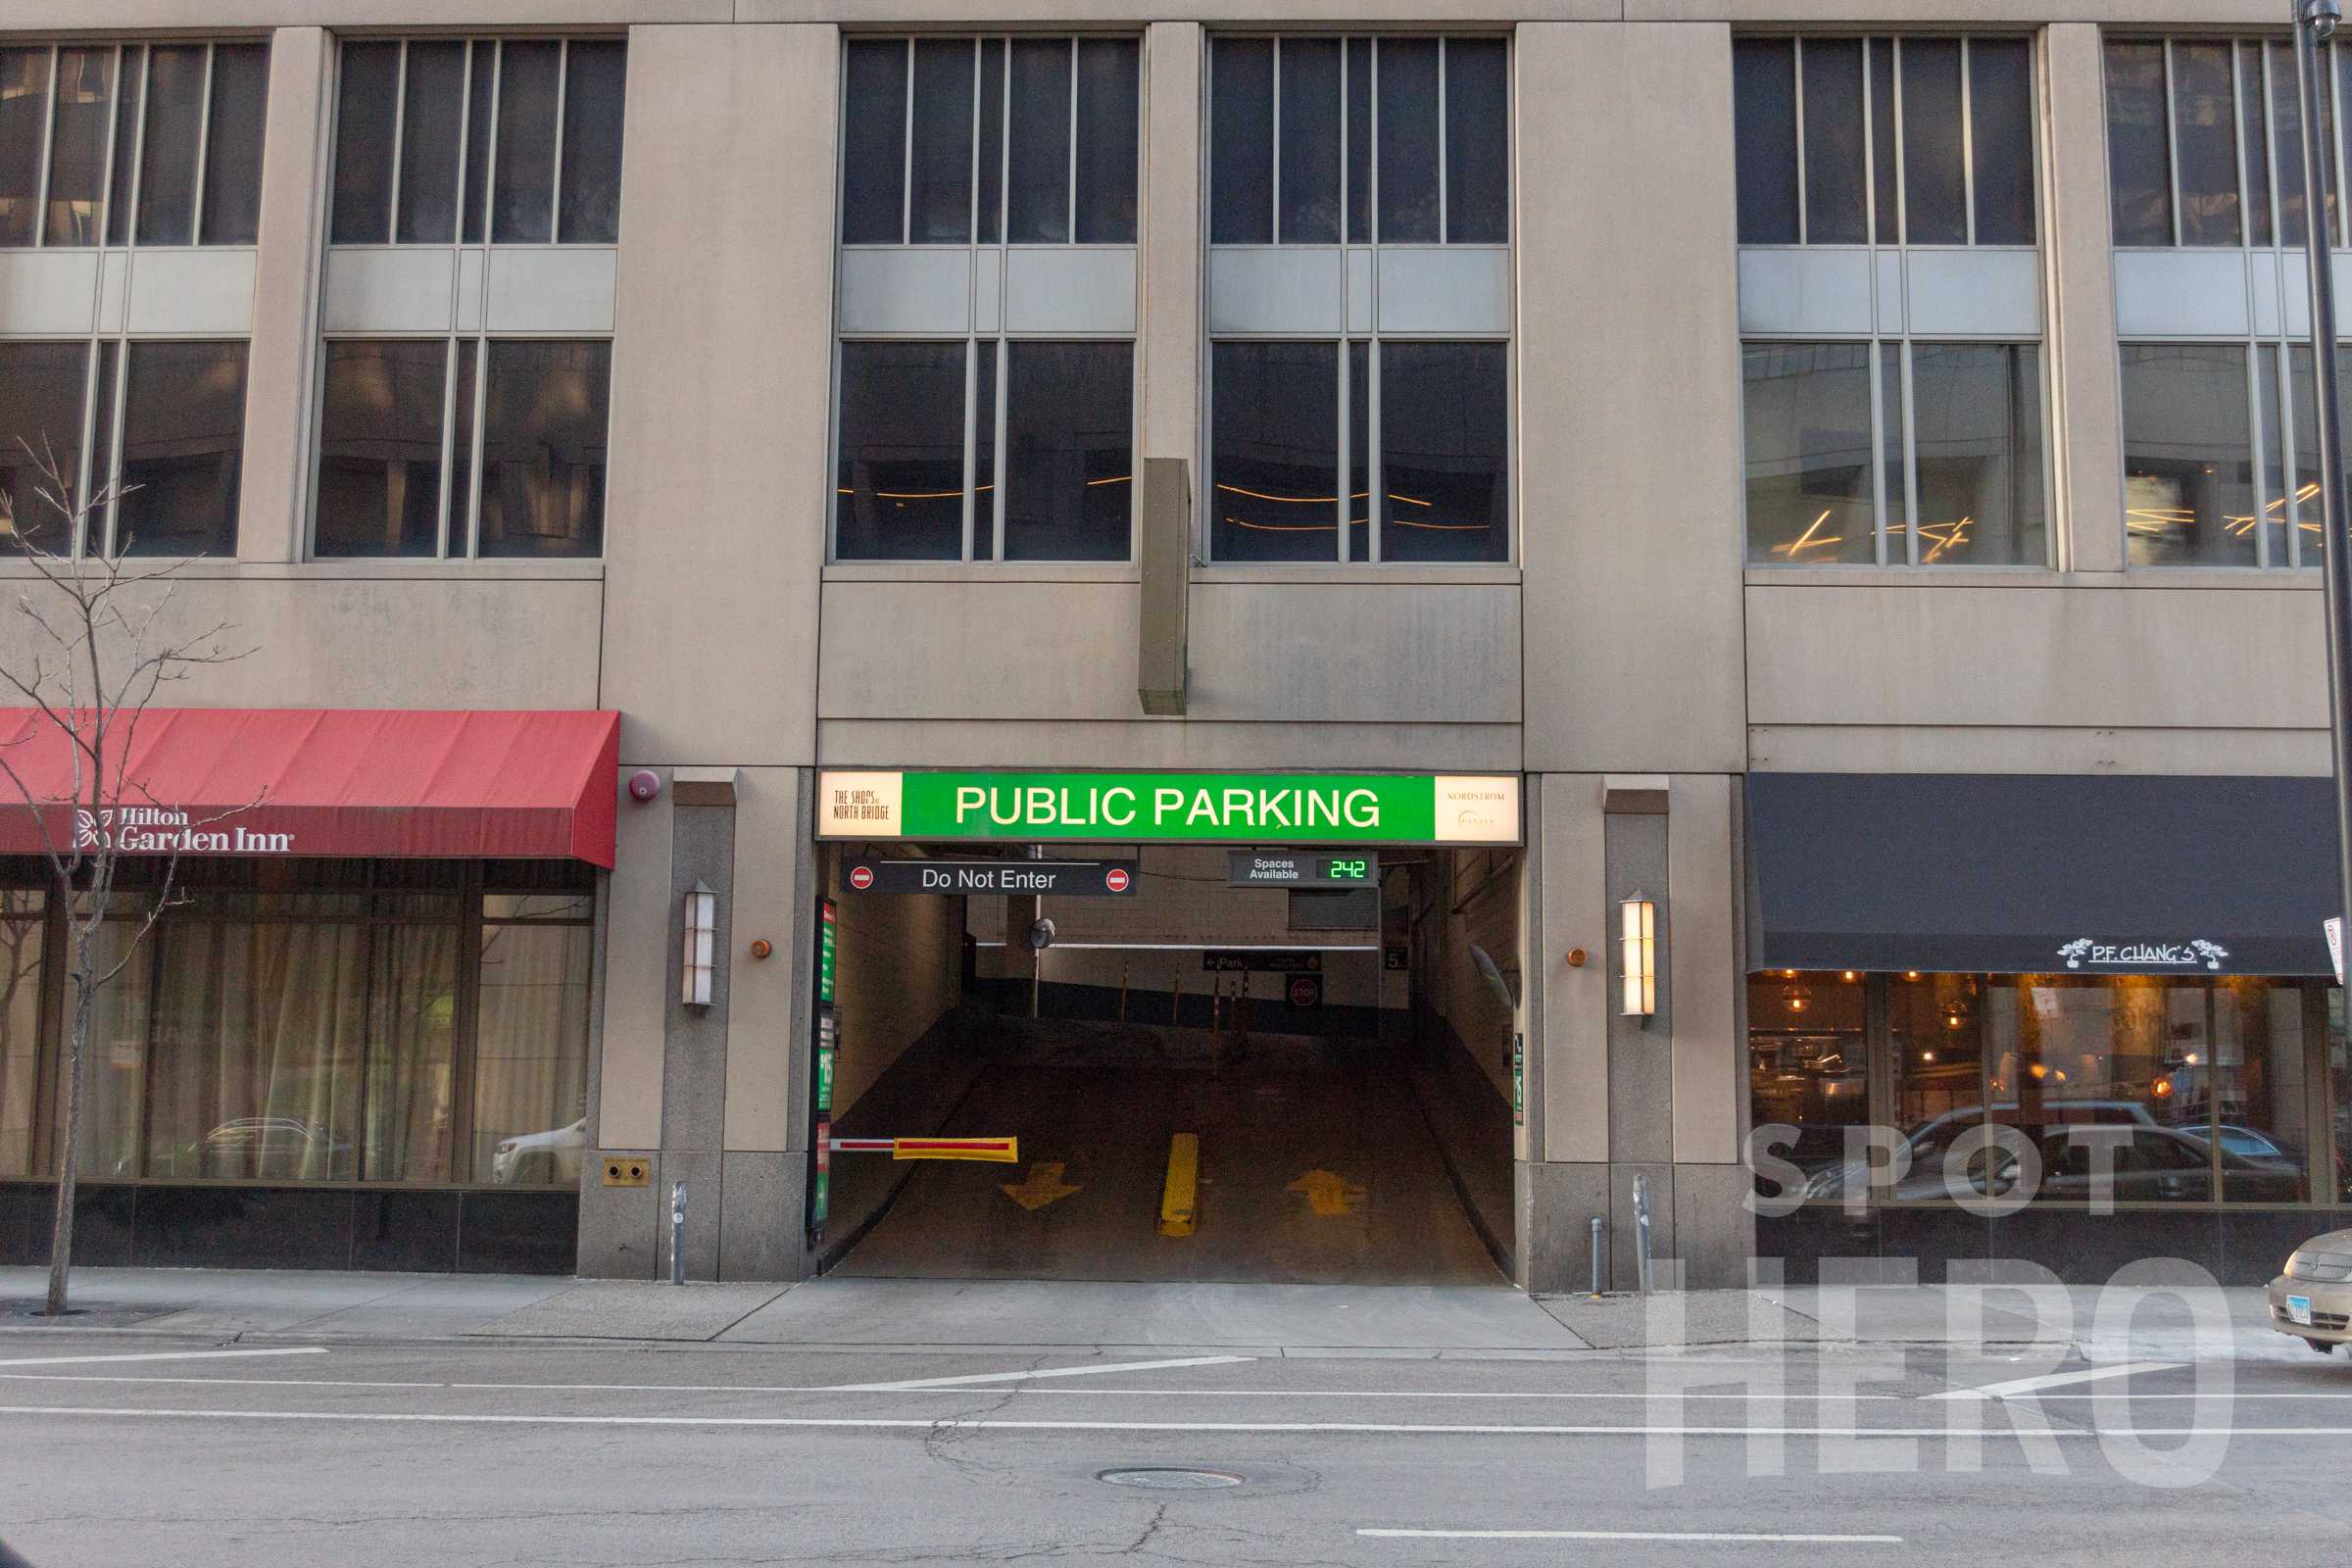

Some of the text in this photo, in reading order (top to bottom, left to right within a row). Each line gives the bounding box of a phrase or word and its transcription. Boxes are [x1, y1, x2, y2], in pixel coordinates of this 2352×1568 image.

[834, 790, 849, 805] THE
[851, 790, 875, 805] SHOPS
[1446, 791, 1506, 802] NORDSTROM
[833, 805, 890, 821] NORTH BRIDGE
[956, 787, 1380, 827] PUBLIC PARKING
[120, 808, 189, 825] Hilton
[121, 826, 291, 852] Garden Inn
[1253, 858, 1295, 870] Spaces
[1330, 860, 1365, 878] 242
[922, 869, 1056, 890] Do Not Enter
[1249, 868, 1299, 880] Available
[2092, 944, 2195, 963] P.F. CHANG'S
[1219, 958, 1244, 968] Park
[1293, 987, 1317, 998] STOP
